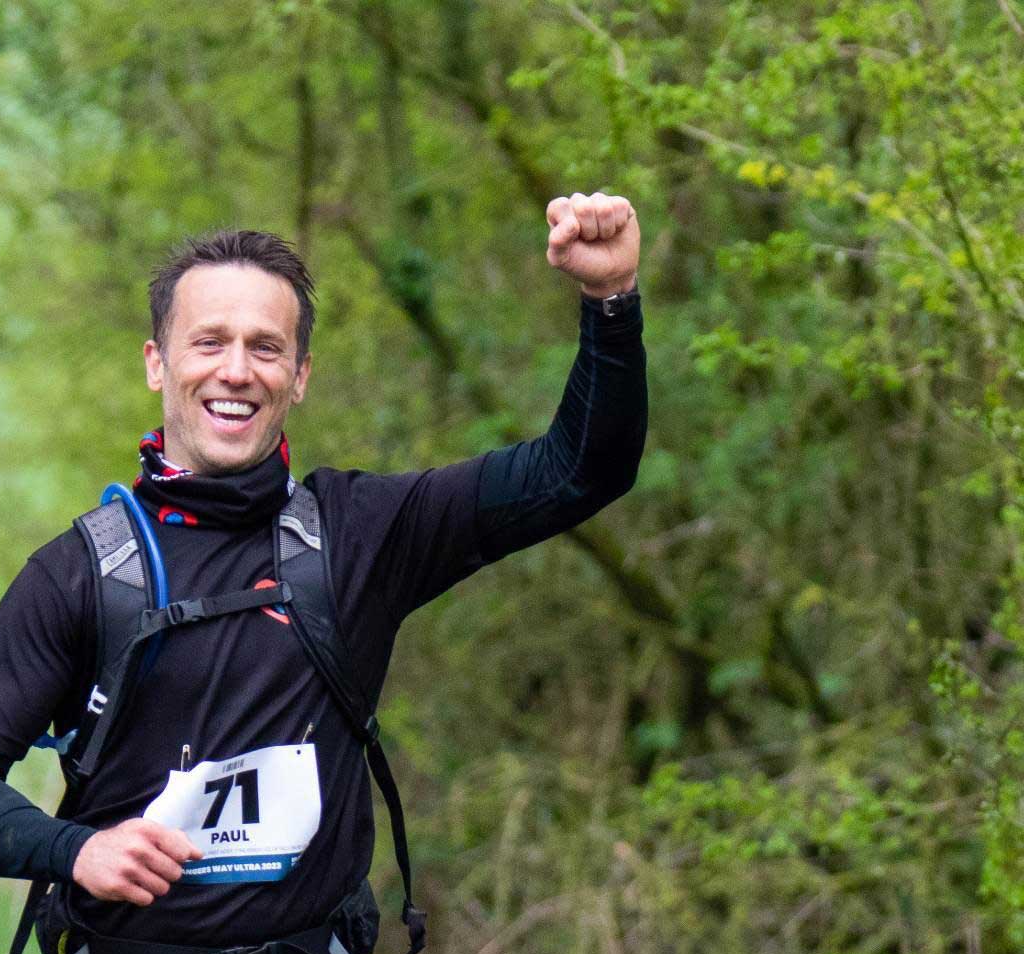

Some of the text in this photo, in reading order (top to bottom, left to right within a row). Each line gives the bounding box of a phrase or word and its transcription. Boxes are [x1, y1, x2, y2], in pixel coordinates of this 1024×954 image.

[201, 768, 260, 830] 71
[211, 830, 249, 844] PAUL
[180, 866, 212, 875] ANGERS
[212, 864, 234, 873] WAY
[234, 863, 261, 872] ULTRA
